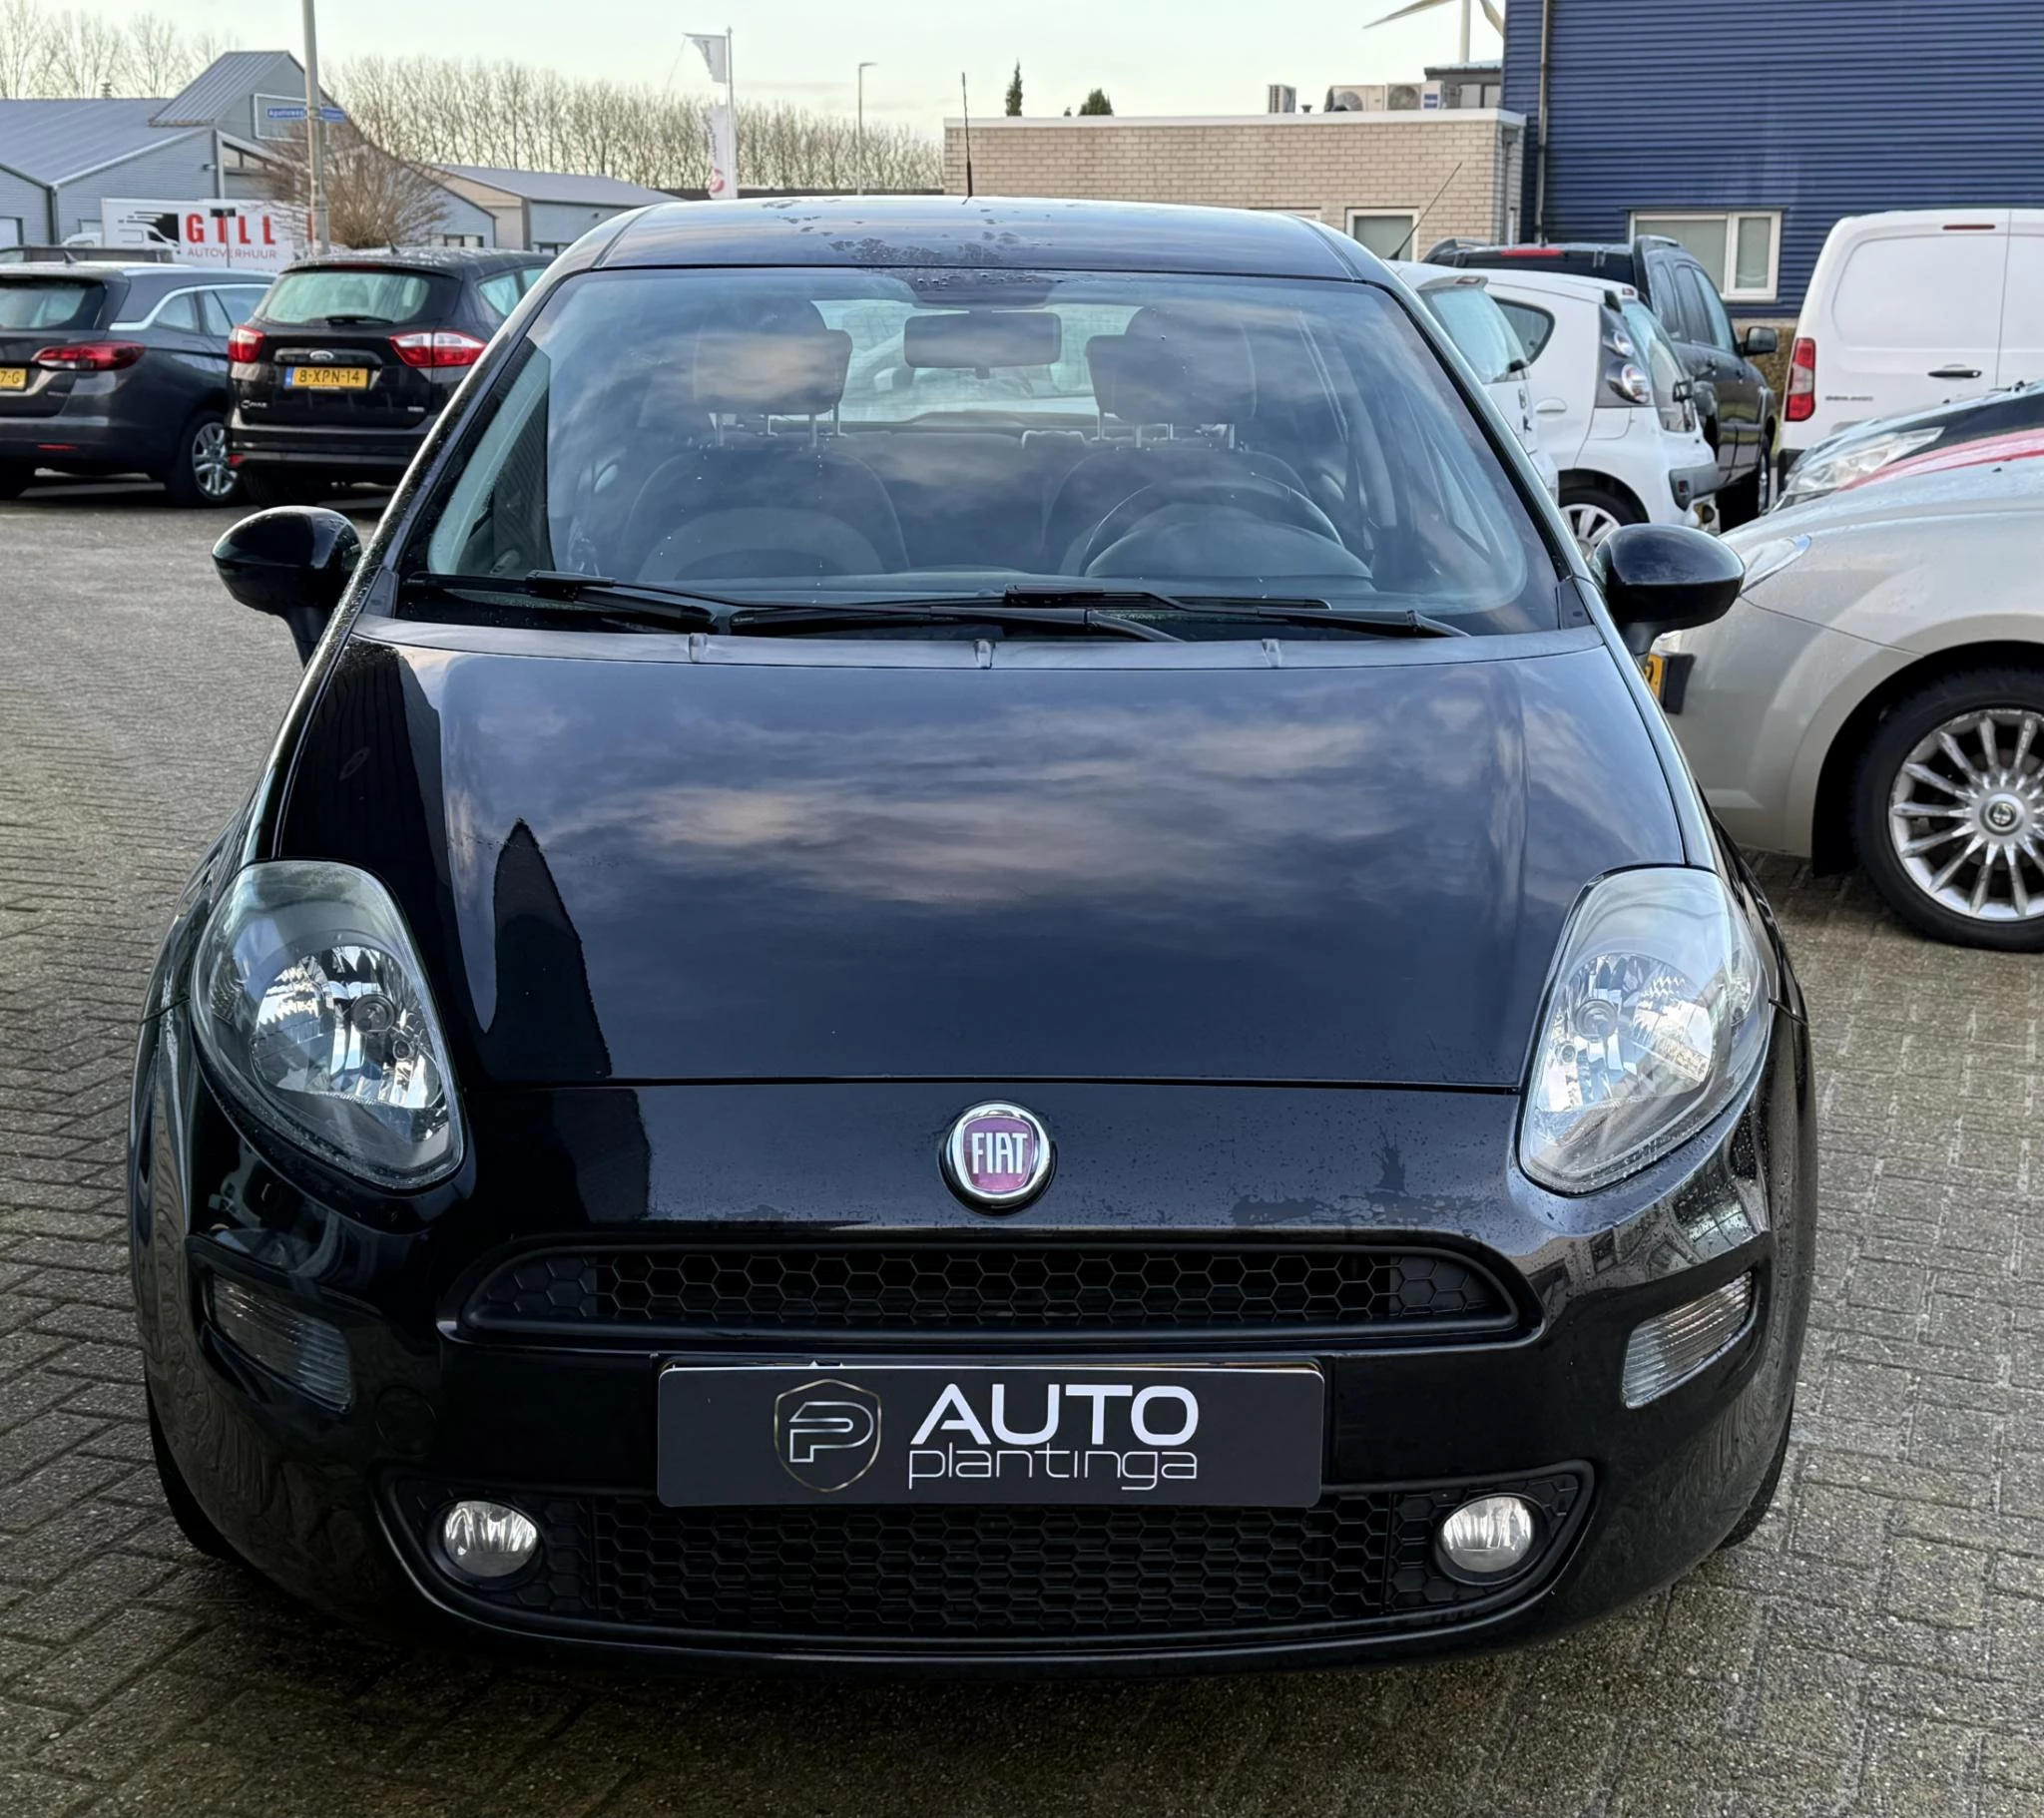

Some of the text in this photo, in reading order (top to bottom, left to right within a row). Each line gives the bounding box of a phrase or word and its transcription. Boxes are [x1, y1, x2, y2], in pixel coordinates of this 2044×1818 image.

[188, 247, 276, 259] AUTOVERHUUR
[298, 369, 360, 384] 8-XPN-14
[971, 1132, 1028, 1174] FIAT
[909, 1382, 1200, 1446] AUTO
[908, 1442, 1198, 1491] plantinga
